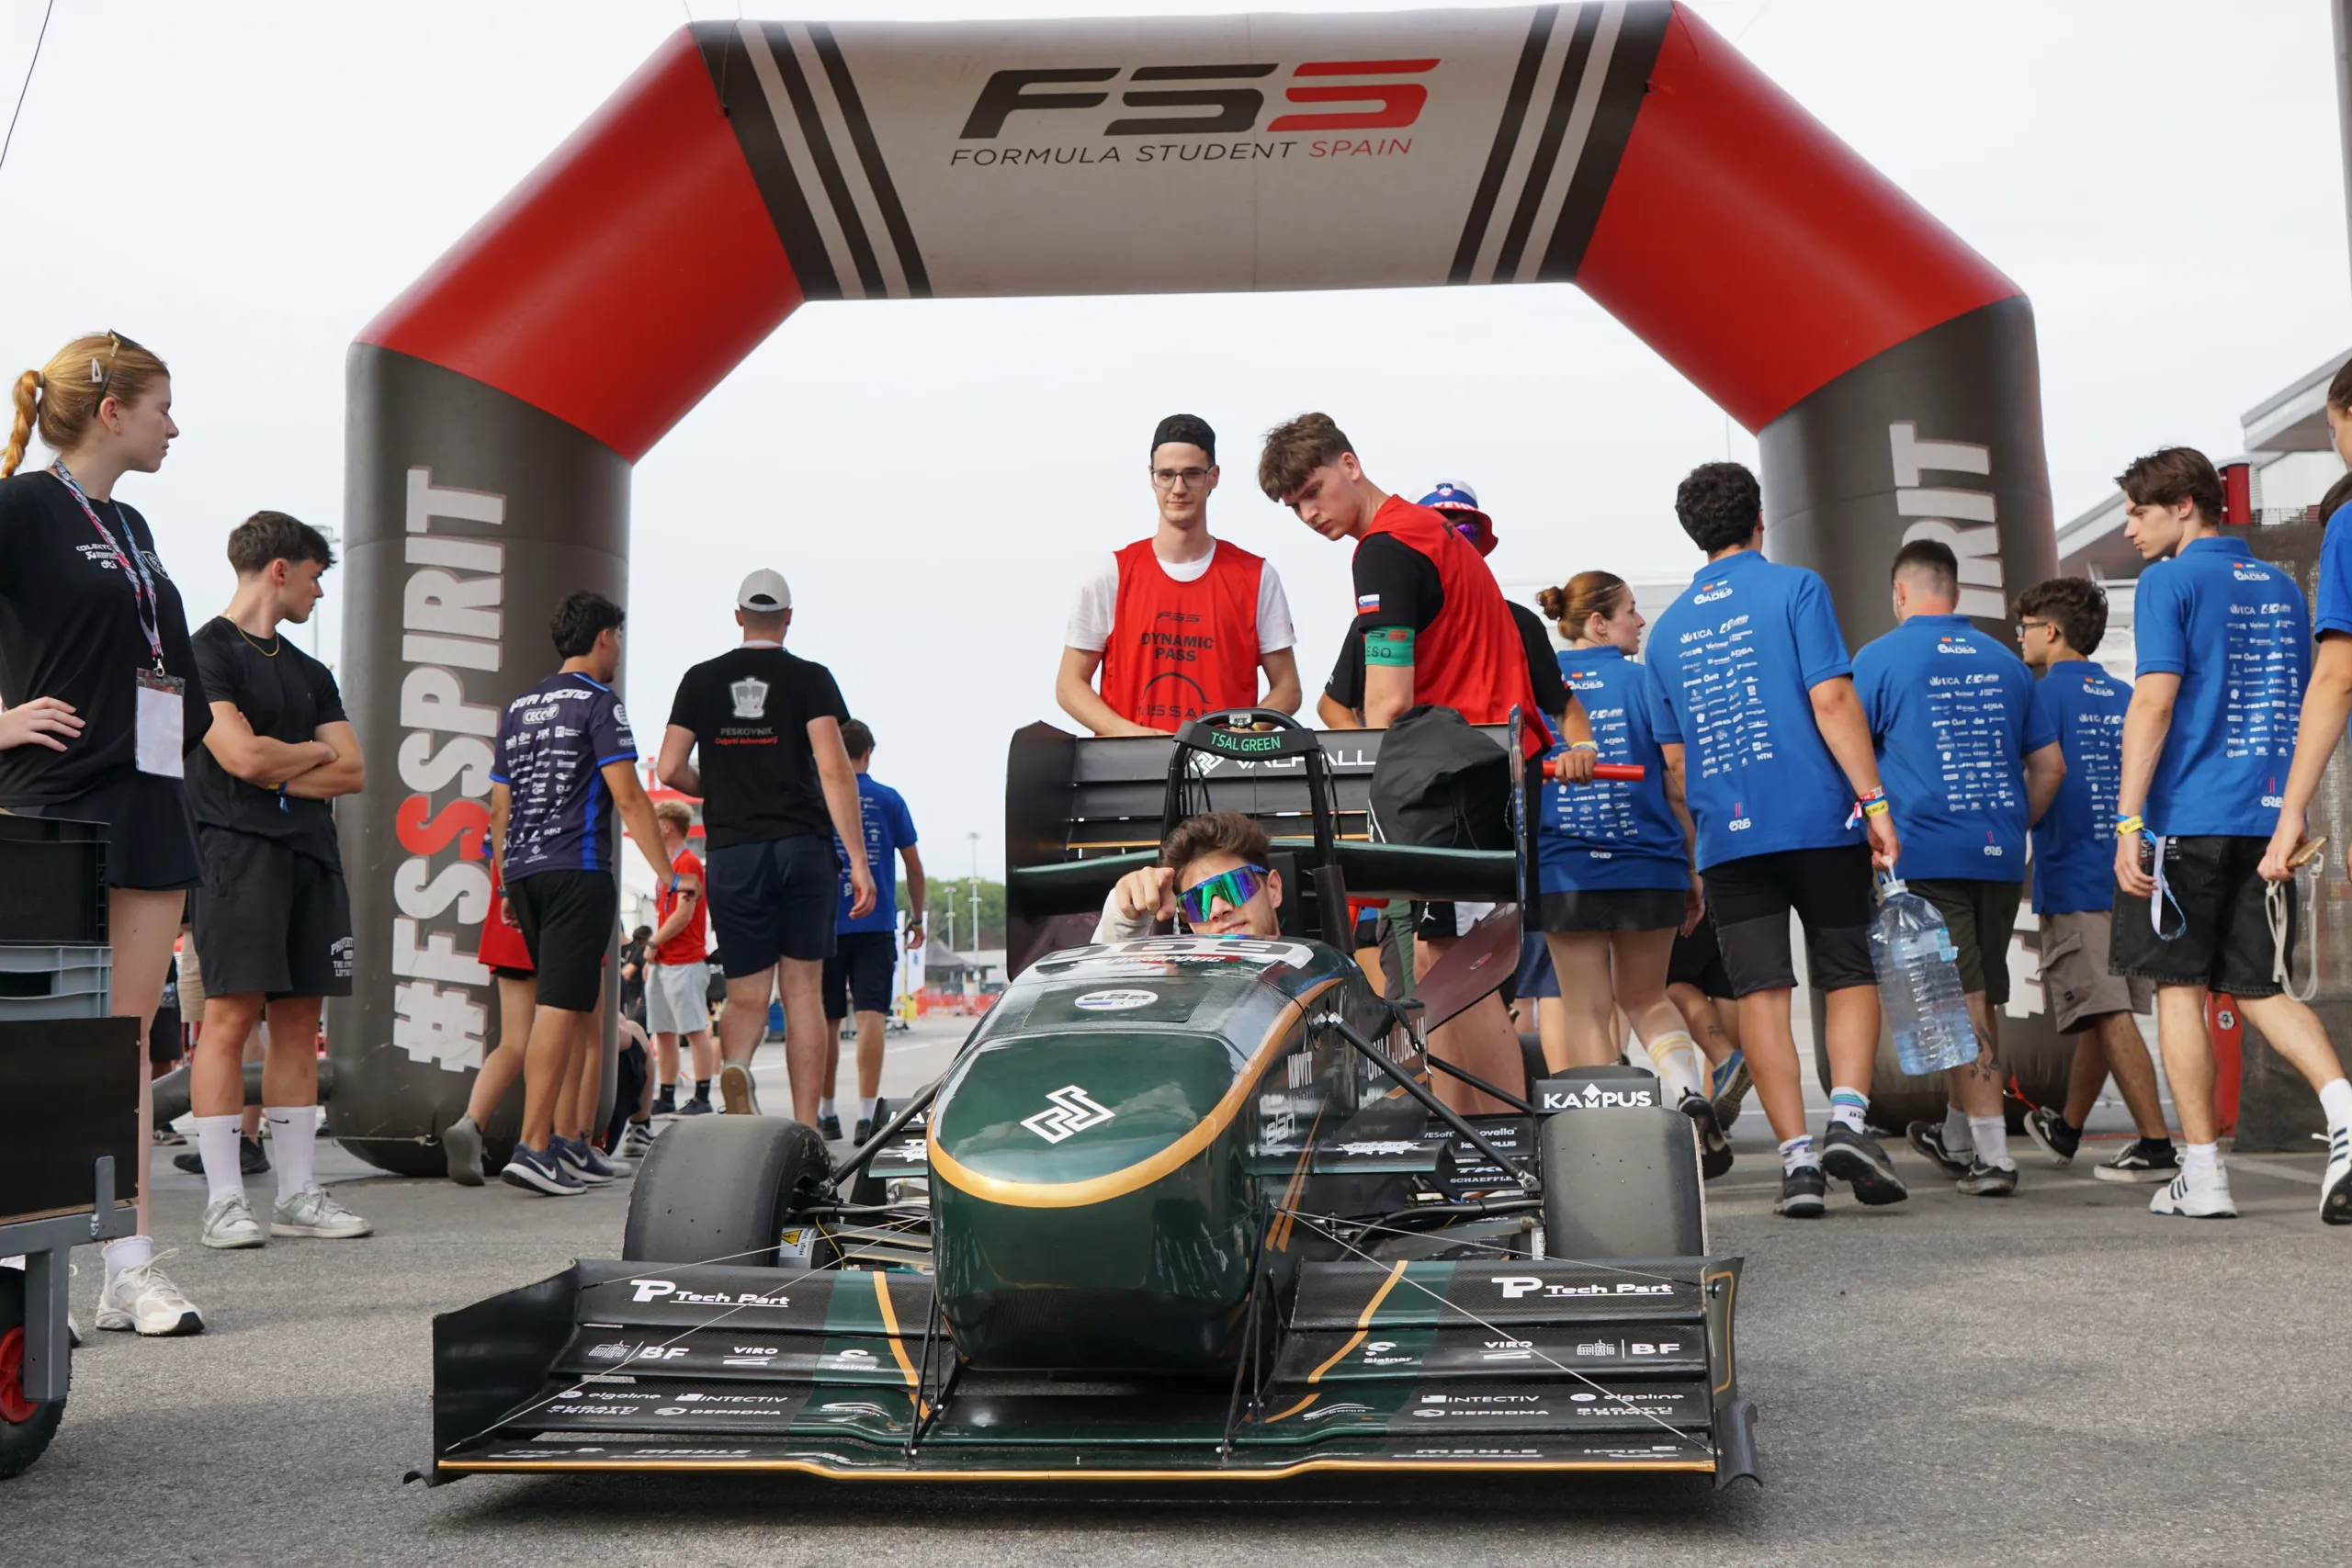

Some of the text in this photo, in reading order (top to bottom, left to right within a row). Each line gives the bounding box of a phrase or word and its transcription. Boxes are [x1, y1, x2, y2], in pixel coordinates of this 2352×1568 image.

[958, 58, 1442, 140] FSS
[950, 138, 1413, 167] FORMULA STUDENT SPAIN
[1158, 612, 1203, 622] FSS
[1141, 632, 1215, 649] DYNAMIC
[1155, 648, 1196, 661] PASS
[1211, 732, 1282, 751] TSAL GREEN
[392, 467, 505, 1072] #FSSSPIRIT
[1288, 1051, 1313, 1089] KOVIT
[1544, 1084, 1652, 1109] KAMPUS
[1266, 1111, 1295, 1146] elan
[1475, 1127, 1515, 1136] ovella
[1545, 1285, 1608, 1294] Tech
[1616, 1283, 1672, 1293] Part
[675, 1291, 731, 1303] Tech
[738, 1293, 790, 1305] Part
[639, 1347, 690, 1359] BF
[733, 1347, 779, 1355] VIRO
[1484, 1340, 1533, 1348] VIRO
[1631, 1343, 1680, 1354] BF
[588, 1392, 662, 1400] elgoline
[1603, 1393, 1684, 1402] elgoline
